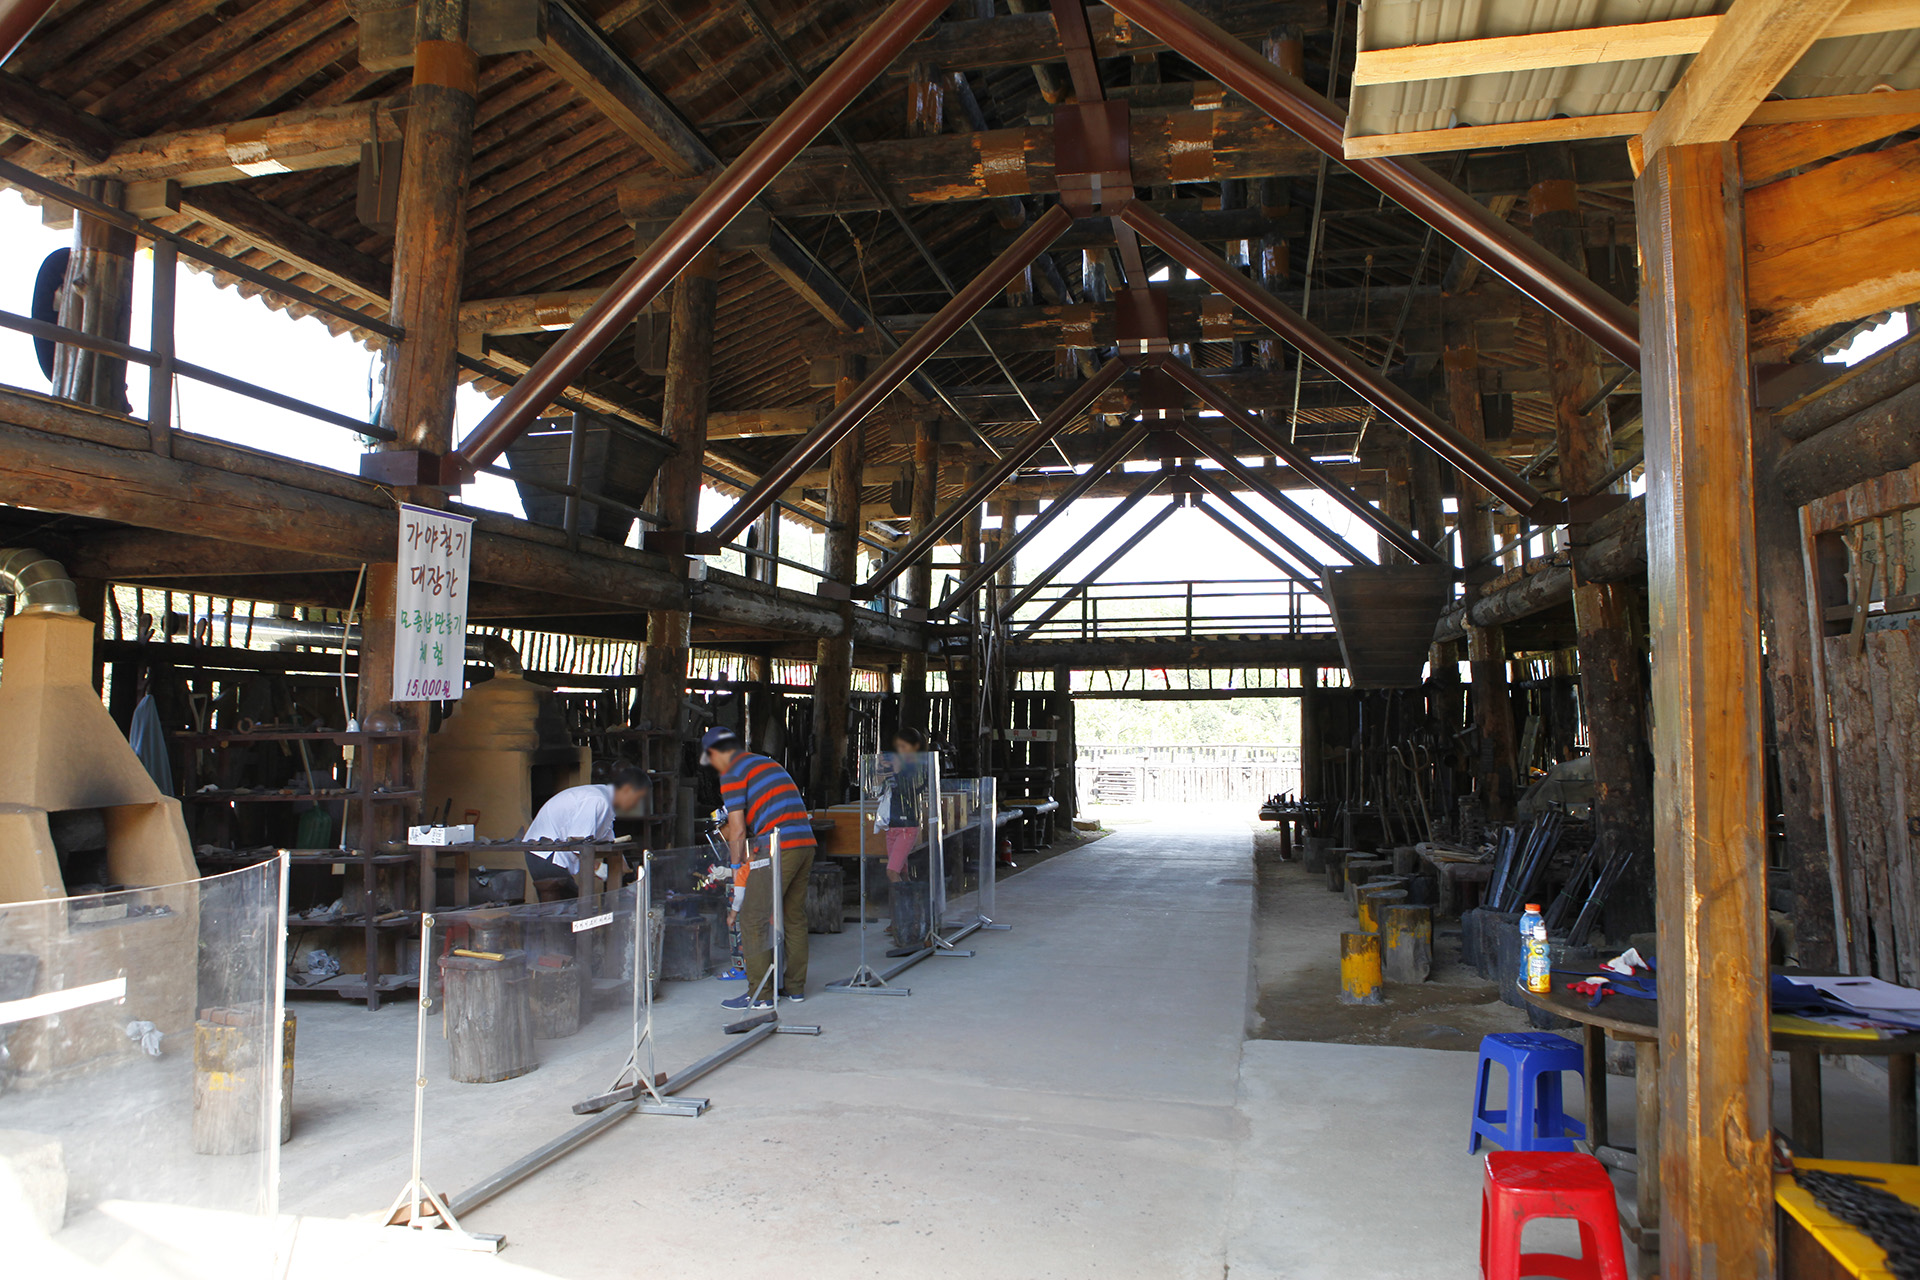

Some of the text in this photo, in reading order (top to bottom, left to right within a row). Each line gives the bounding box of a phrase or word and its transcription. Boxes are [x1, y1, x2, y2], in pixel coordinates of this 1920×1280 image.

[406, 521, 467, 558] 가야철기
[410, 564, 458, 598] 대장간
[406, 679, 451, 698] 15,000원
